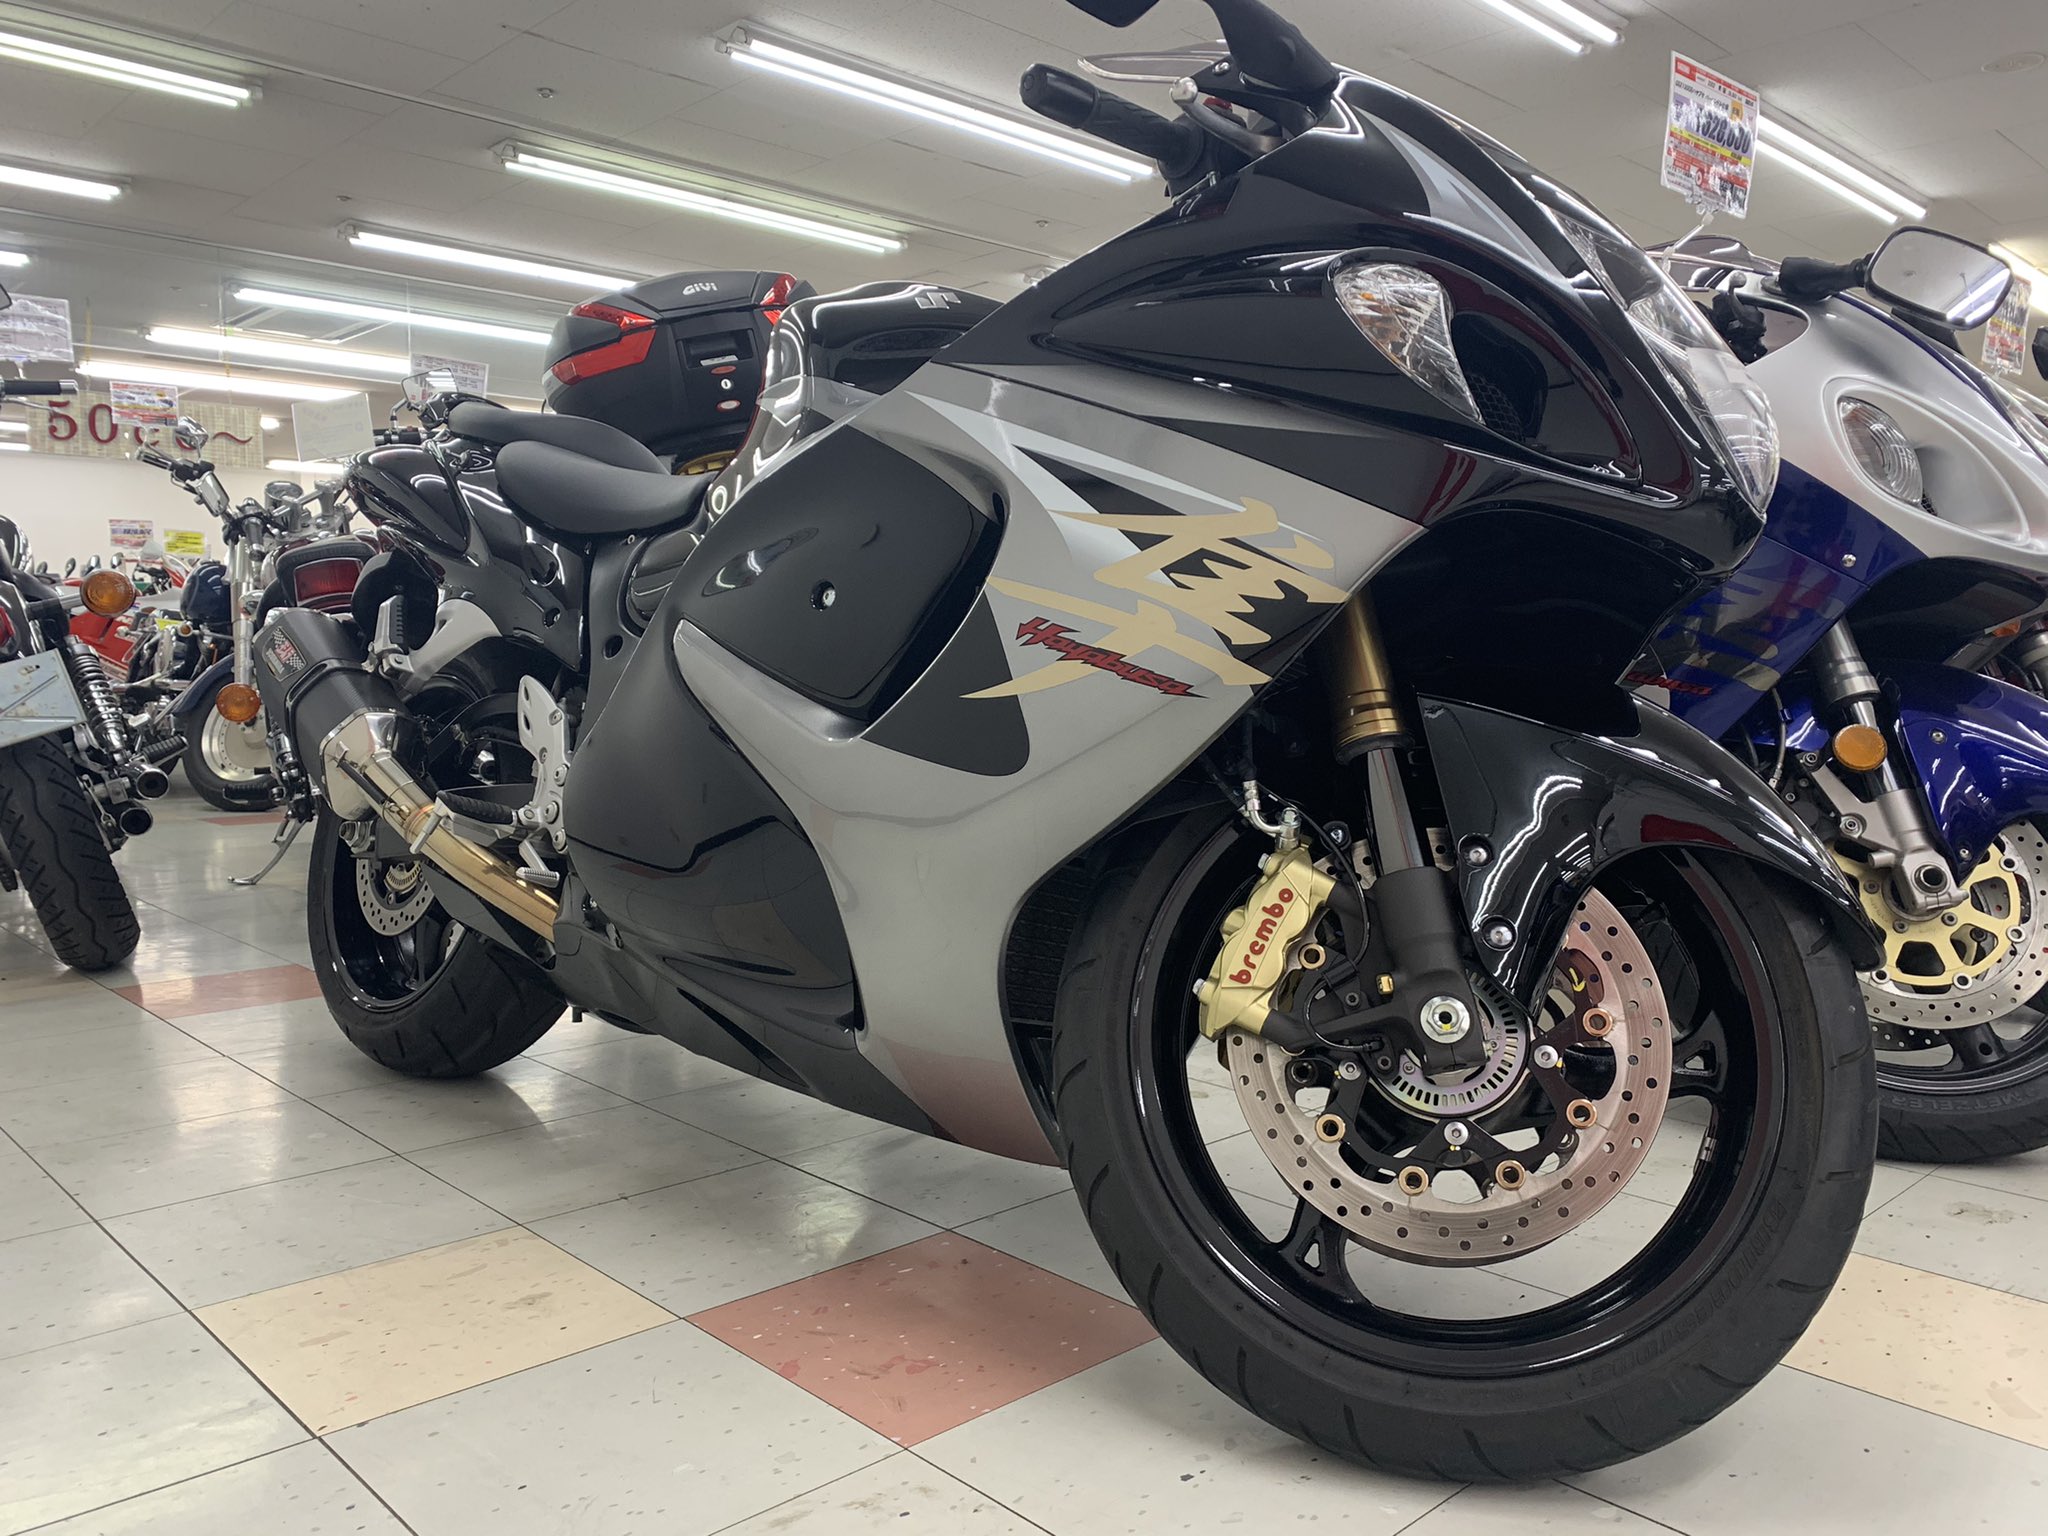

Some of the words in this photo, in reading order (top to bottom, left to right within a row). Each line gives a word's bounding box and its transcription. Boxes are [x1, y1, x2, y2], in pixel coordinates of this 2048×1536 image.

[682, 281, 718, 296] GIVI
[1016, 617, 1211, 699] Hayabusa
[1229, 888, 1294, 985] brembo
